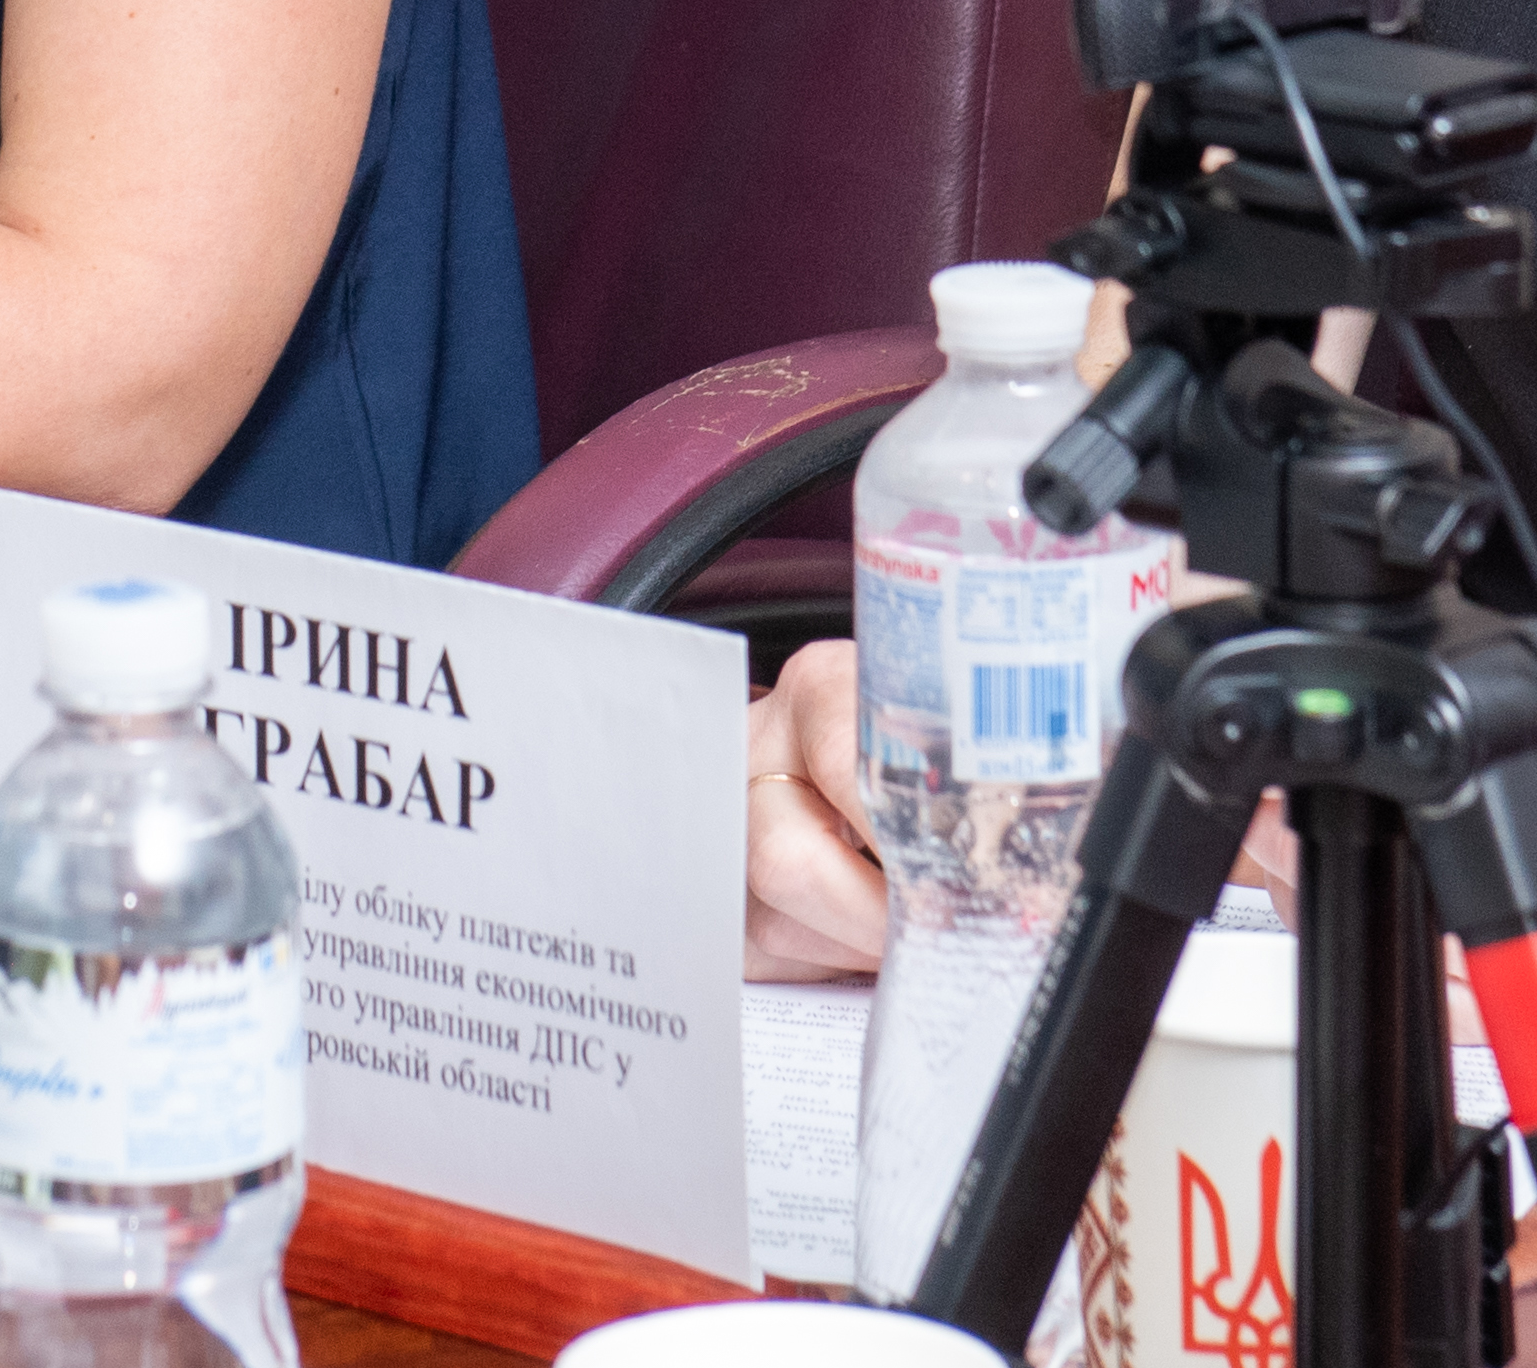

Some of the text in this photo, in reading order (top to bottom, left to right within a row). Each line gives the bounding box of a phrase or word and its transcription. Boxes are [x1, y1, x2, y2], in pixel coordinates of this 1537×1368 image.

[228, 601, 469, 720] ІРИНА
[198, 703, 497, 833] ГРАБАР
[302, 925, 688, 1041] управління економічного
[353, 882, 449, 944] обліку
[458, 913, 596, 969] платежів
[603, 947, 637, 980] та
[353, 988, 520, 1054] управління
[528, 1022, 604, 1073] ДПС
[614, 1050, 632, 1089] у
[439, 1056, 556, 1114] області
